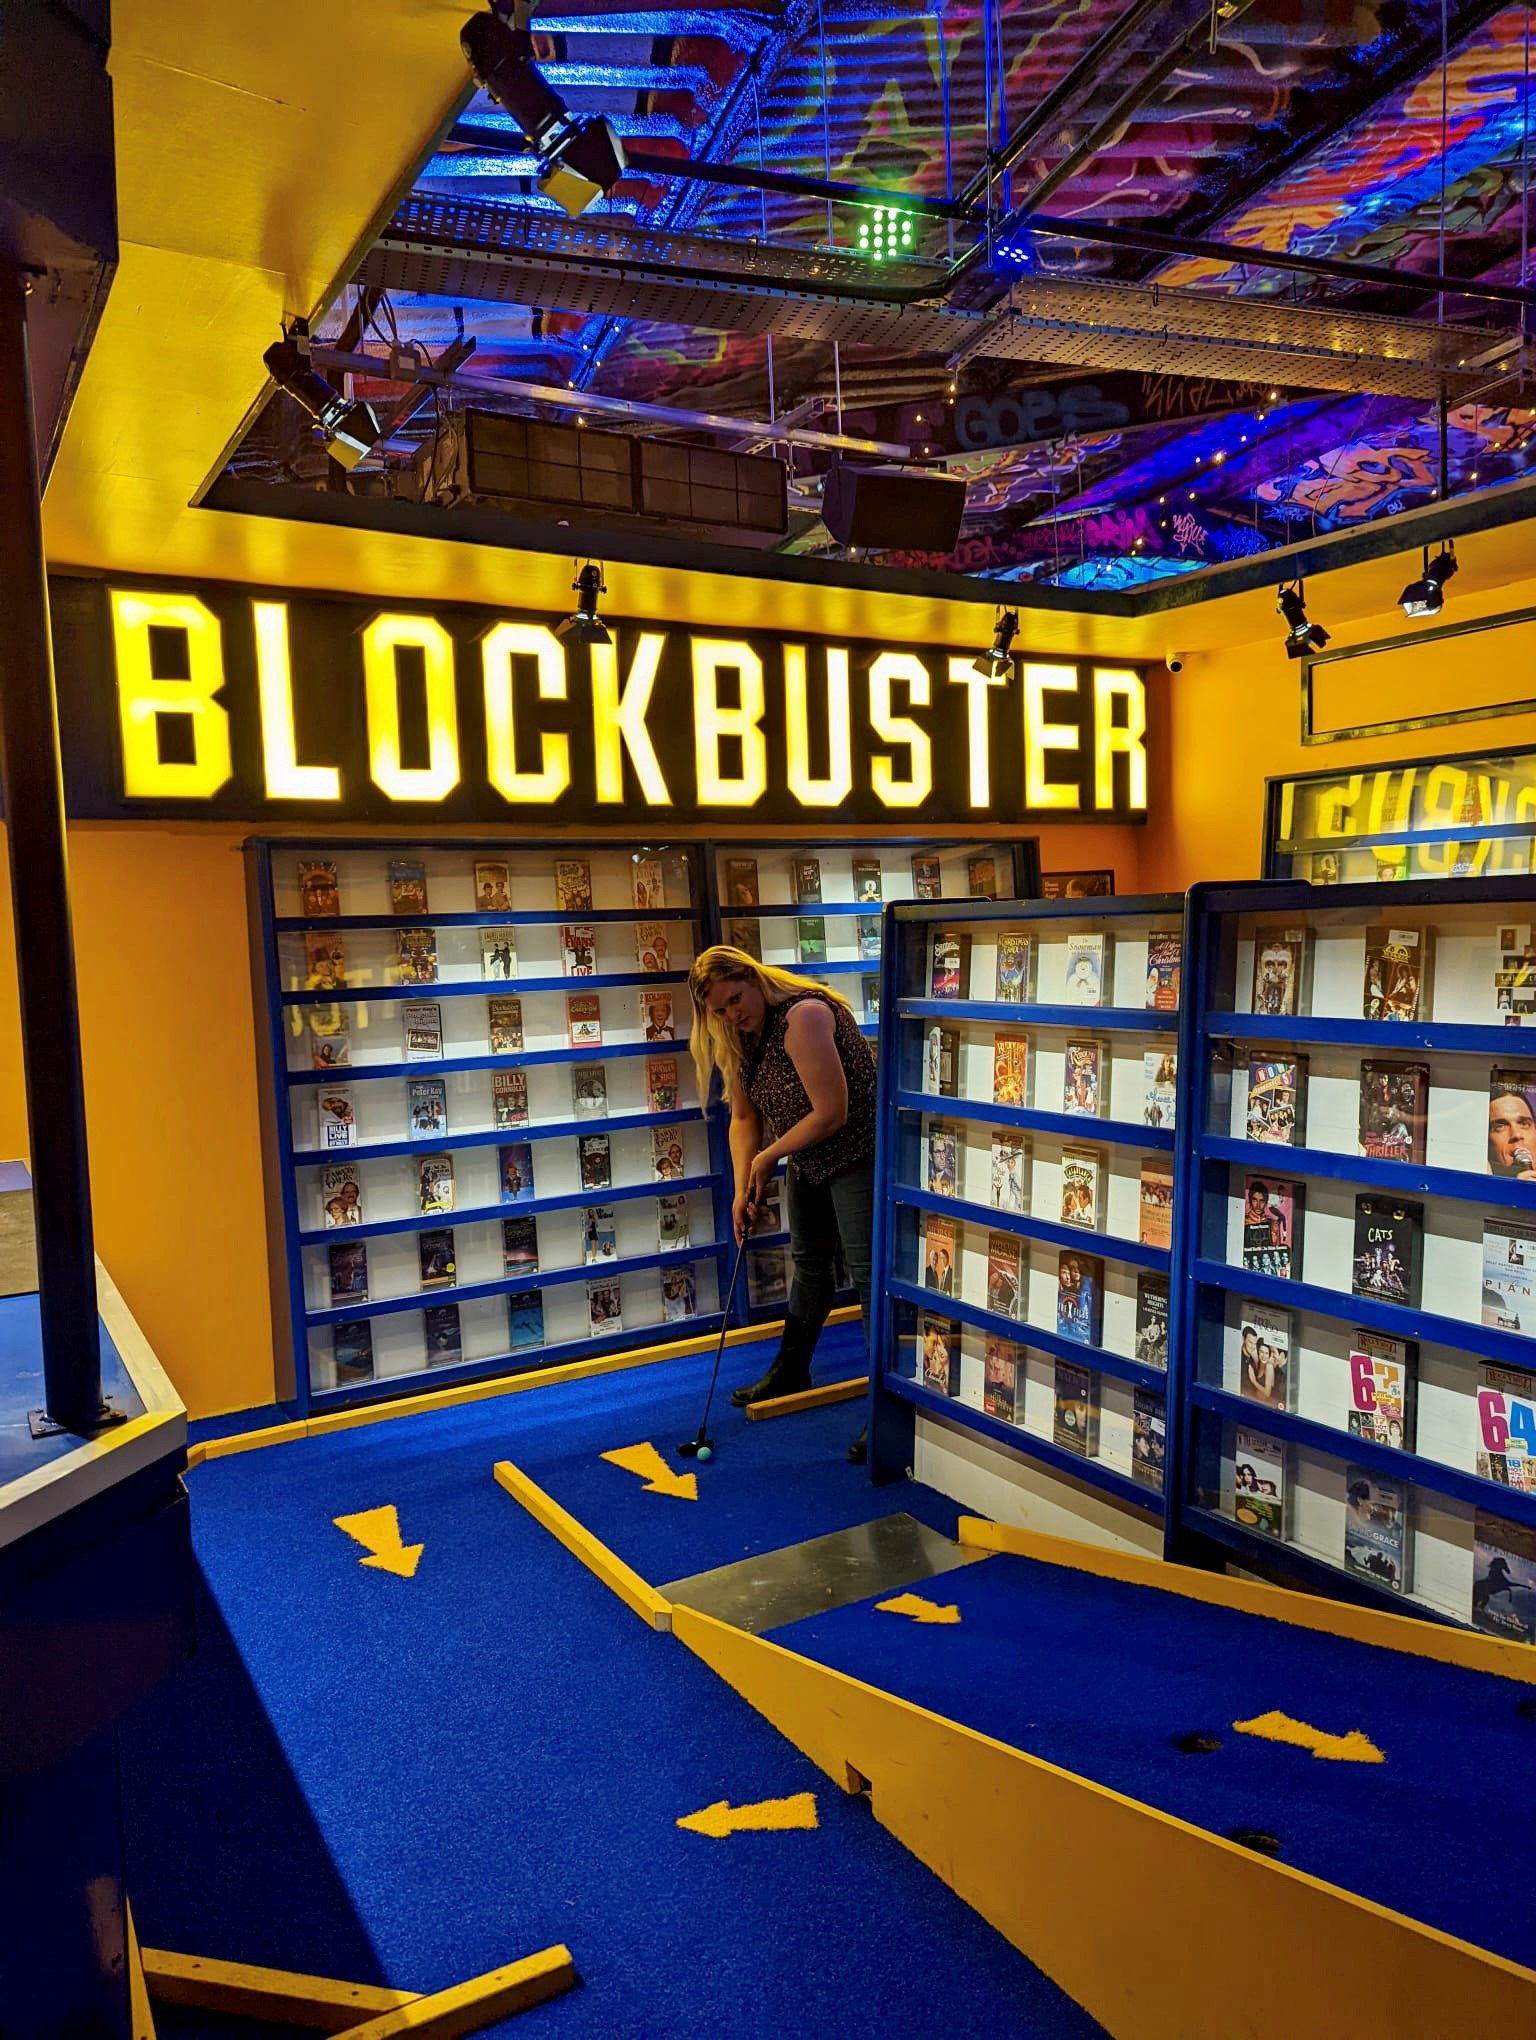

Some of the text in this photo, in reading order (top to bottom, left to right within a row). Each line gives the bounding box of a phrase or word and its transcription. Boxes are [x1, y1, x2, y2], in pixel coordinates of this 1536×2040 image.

[109, 588, 1147, 809] BLOCKBUSTER
[1070, 943, 1102, 951] Snowman
[495, 1075, 525, 1087] BILLY
[1364, 1143, 1408, 1158] THRILLER
[1064, 1166, 1093, 1184] CASABLANCA
[1368, 1228, 1393, 1242] CATS
[1067, 1301, 1073, 1319] X
[1478, 1391, 1536, 1457] 64
[1508, 1458, 1521, 1467] 18
[1373, 1532, 1399, 1548] GRACE
